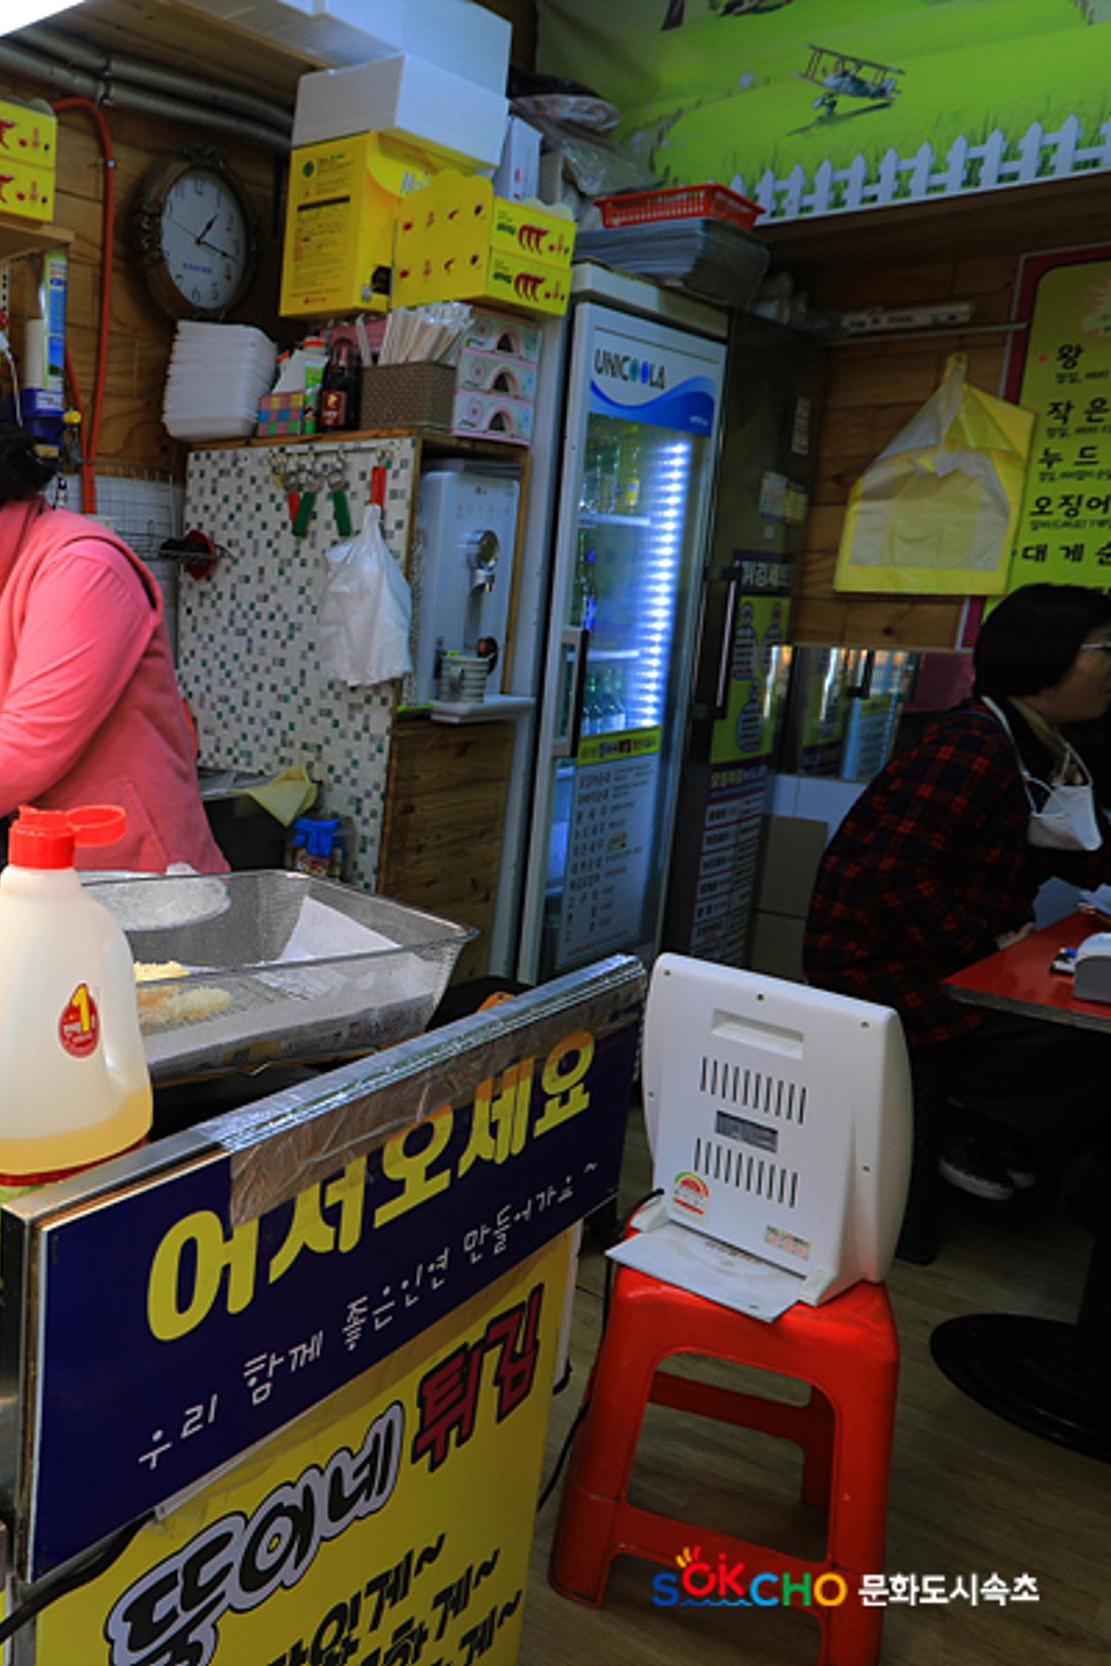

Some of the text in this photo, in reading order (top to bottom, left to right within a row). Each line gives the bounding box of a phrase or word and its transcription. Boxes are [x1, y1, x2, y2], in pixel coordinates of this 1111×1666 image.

[147, 1028, 595, 1342] 어서오세요
[138, 1393, 217, 1471] 우리
[244, 1330, 323, 1405] 함께
[412, 1283, 545, 1472] 튀김
